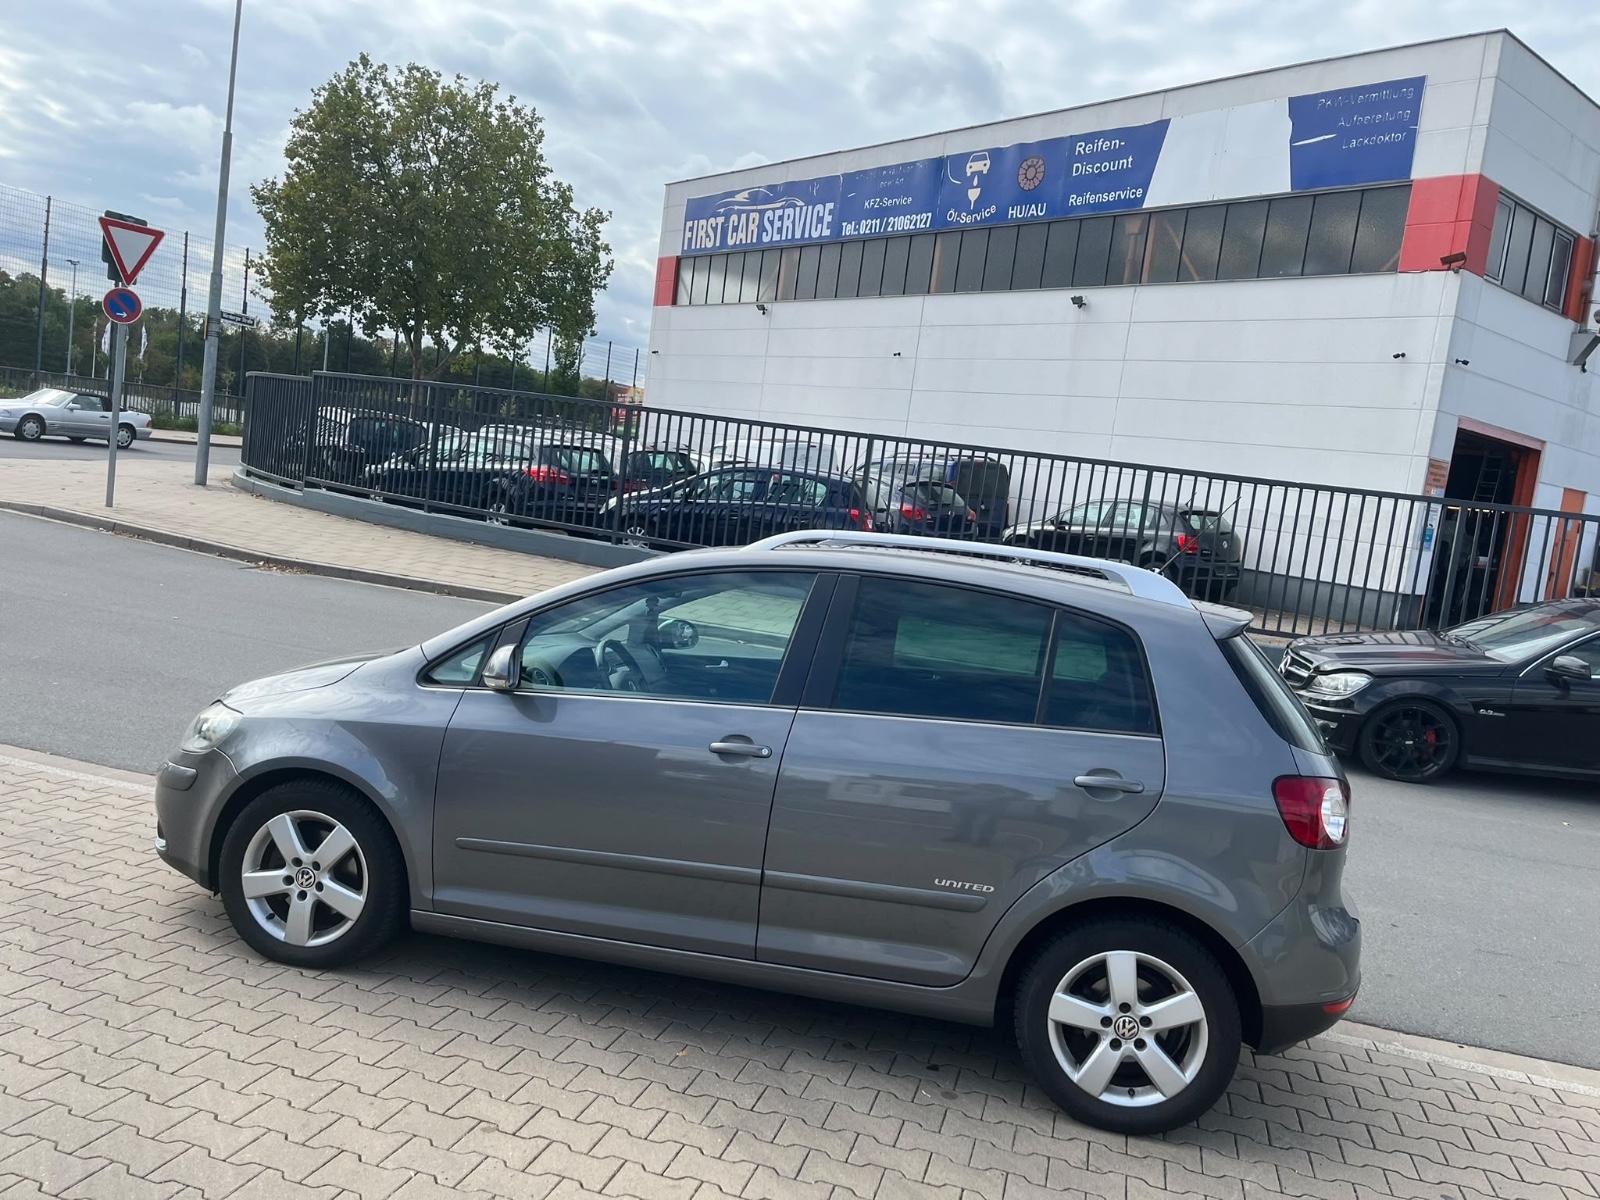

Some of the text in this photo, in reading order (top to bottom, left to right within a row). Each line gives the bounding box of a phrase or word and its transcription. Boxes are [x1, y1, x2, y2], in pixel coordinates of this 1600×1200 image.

[1075, 138, 1126, 156] Reifen-
[1342, 132, 1407, 150] Lackdoktor
[1072, 155, 1133, 177] Discount
[864, 195, 912, 209] KFZ-Service
[1068, 187, 1143, 207] Reifenservice
[947, 204, 997, 224] Öl-Service
[1008, 203, 1047, 219] HU/AU
[684, 202, 835, 250] FIRST CAR SERVICE
[842, 221, 859, 236] Tel.:
[860, 218, 880, 234] 0211
[887, 212, 932, 232] 21062127
[934, 878, 995, 893] UNITED
